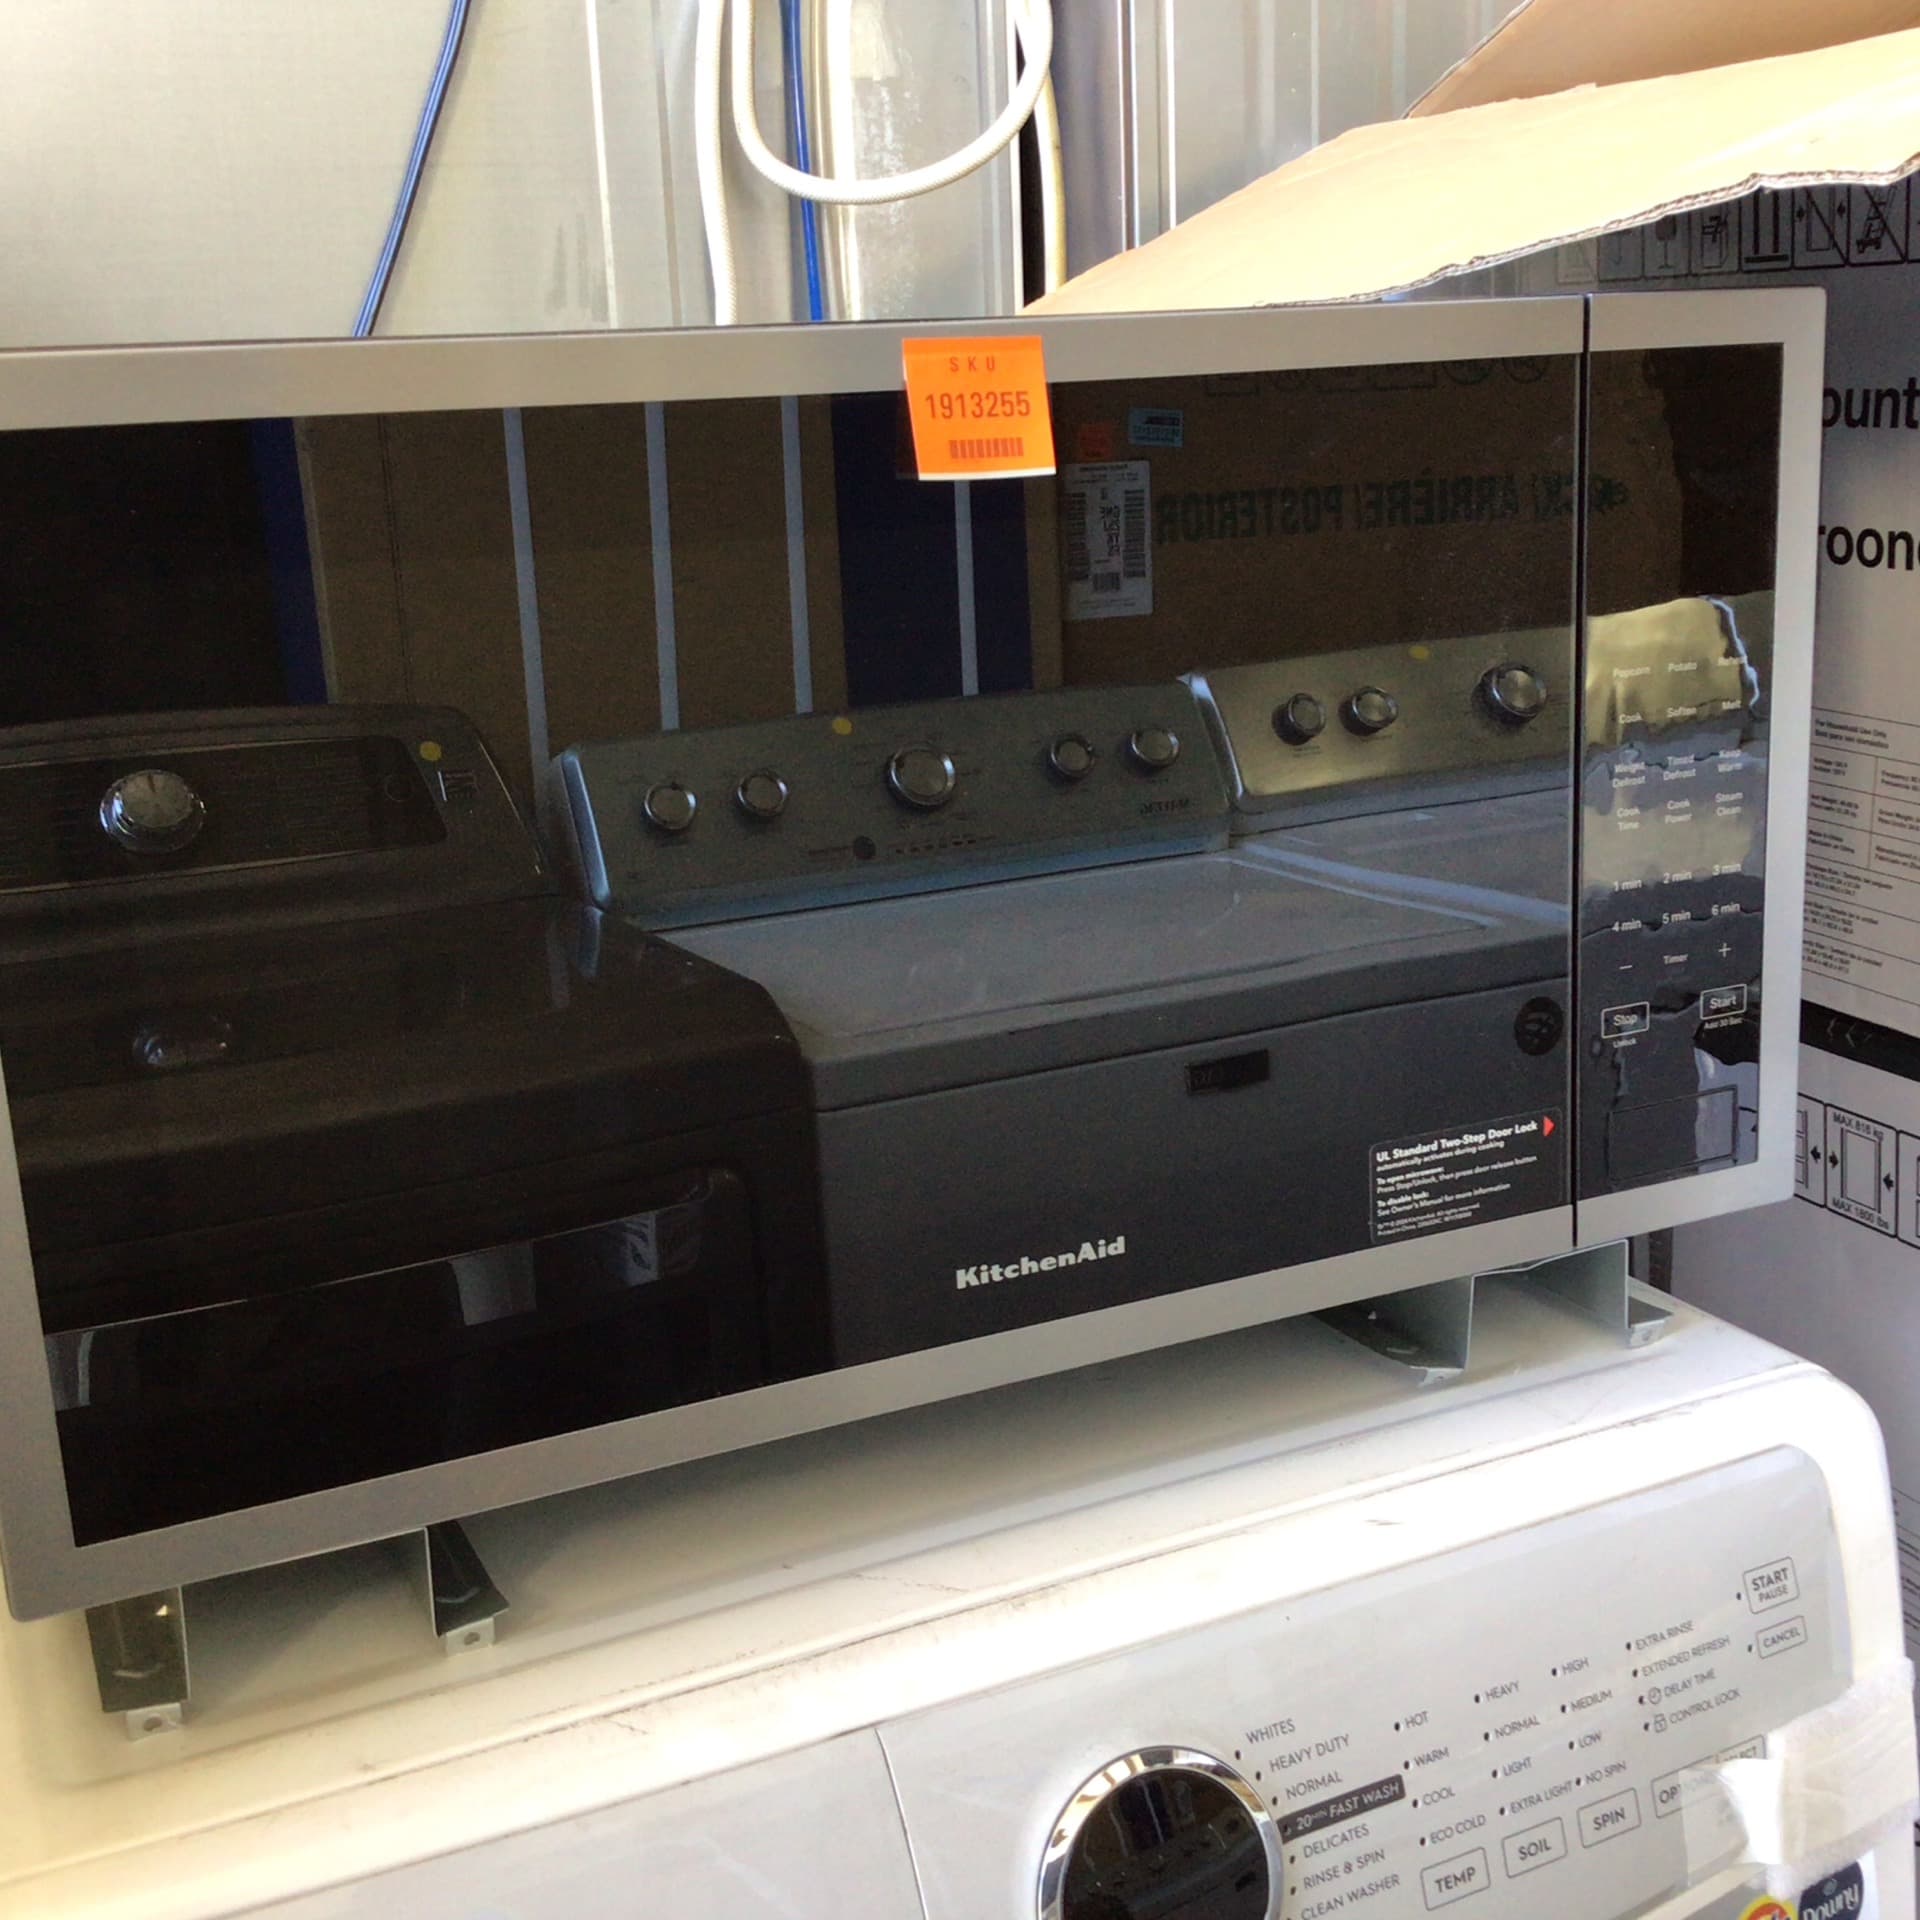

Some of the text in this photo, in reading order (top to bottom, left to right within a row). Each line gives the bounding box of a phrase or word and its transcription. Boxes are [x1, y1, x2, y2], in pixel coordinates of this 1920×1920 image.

[925, 390, 1031, 420] 1913255
[1618, 713, 1642, 724] Cook
[1617, 807, 1640, 818] Cook
[1667, 799, 1690, 810] Cook
[1716, 806, 1742, 817] Clean
[1663, 870, 1692, 884] 2 min
[1712, 862, 1742, 876] 3 min
[1614, 879, 1642, 891] 1 min
[1662, 910, 1691, 924] 5 min
[1712, 902, 1741, 916] 6 min
[1612, 918, 1642, 932] 4 min
[1663, 954, 1689, 965] Timer
[1710, 995, 1737, 1010] Start
[1613, 1013, 1638, 1027] Stop
[1376, 1120, 1538, 1162] UL Standard Two-Step Door Lock
[956, 1235, 1126, 1290] KitchenAid
[1751, 1567, 1789, 1592] START
[1757, 1584, 1789, 1603] PAUSE
[1635, 1620, 1694, 1650] EXTRA RINSE
[1762, 1626, 1801, 1650] CANCEL
[1561, 1657, 1590, 1675] HIGH
[1641, 1650, 1690, 1677] EXTENDED
[1484, 1681, 1520, 1701] HEAVY
[1663, 1667, 1716, 1698] DELAY TIME
[1569, 1689, 1613, 1712] MEDIUM
[1668, 1687, 1741, 1724] CONTROL LOCK
[1245, 1717, 1296, 1745] WHITES
[1404, 1710, 1430, 1729] HOT
[1494, 1714, 1541, 1740] NORMAL
[1578, 1729, 1603, 1749] LOW
[1269, 1733, 1350, 1773] HEAVY DUTY
[1413, 1746, 1450, 1767] WARM
[1502, 1756, 1532, 1777] LIGHT
[1584, 1760, 1628, 1785] NO SPIN
[1285, 1769, 1344, 1800] NORMAL
[1422, 1786, 1456, 1806] COOL
[1509, 1779, 1573, 1814] EXTRA LIGHT
[1329, 1795, 1361, 1818] FAST
[1362, 1780, 1400, 1804] WASH
[1429, 1813, 1487, 1845] ECO COLD
[1592, 1806, 1626, 1832] SPIN
[1302, 1822, 1371, 1859] DELICATES
[1517, 1836, 1552, 1861] SOIL
[1302, 1848, 1387, 1891] RINSE & SPIN
[1433, 1865, 1477, 1894] TEMP
[1300, 1873, 1401, 1920] CLEAN WASHER
